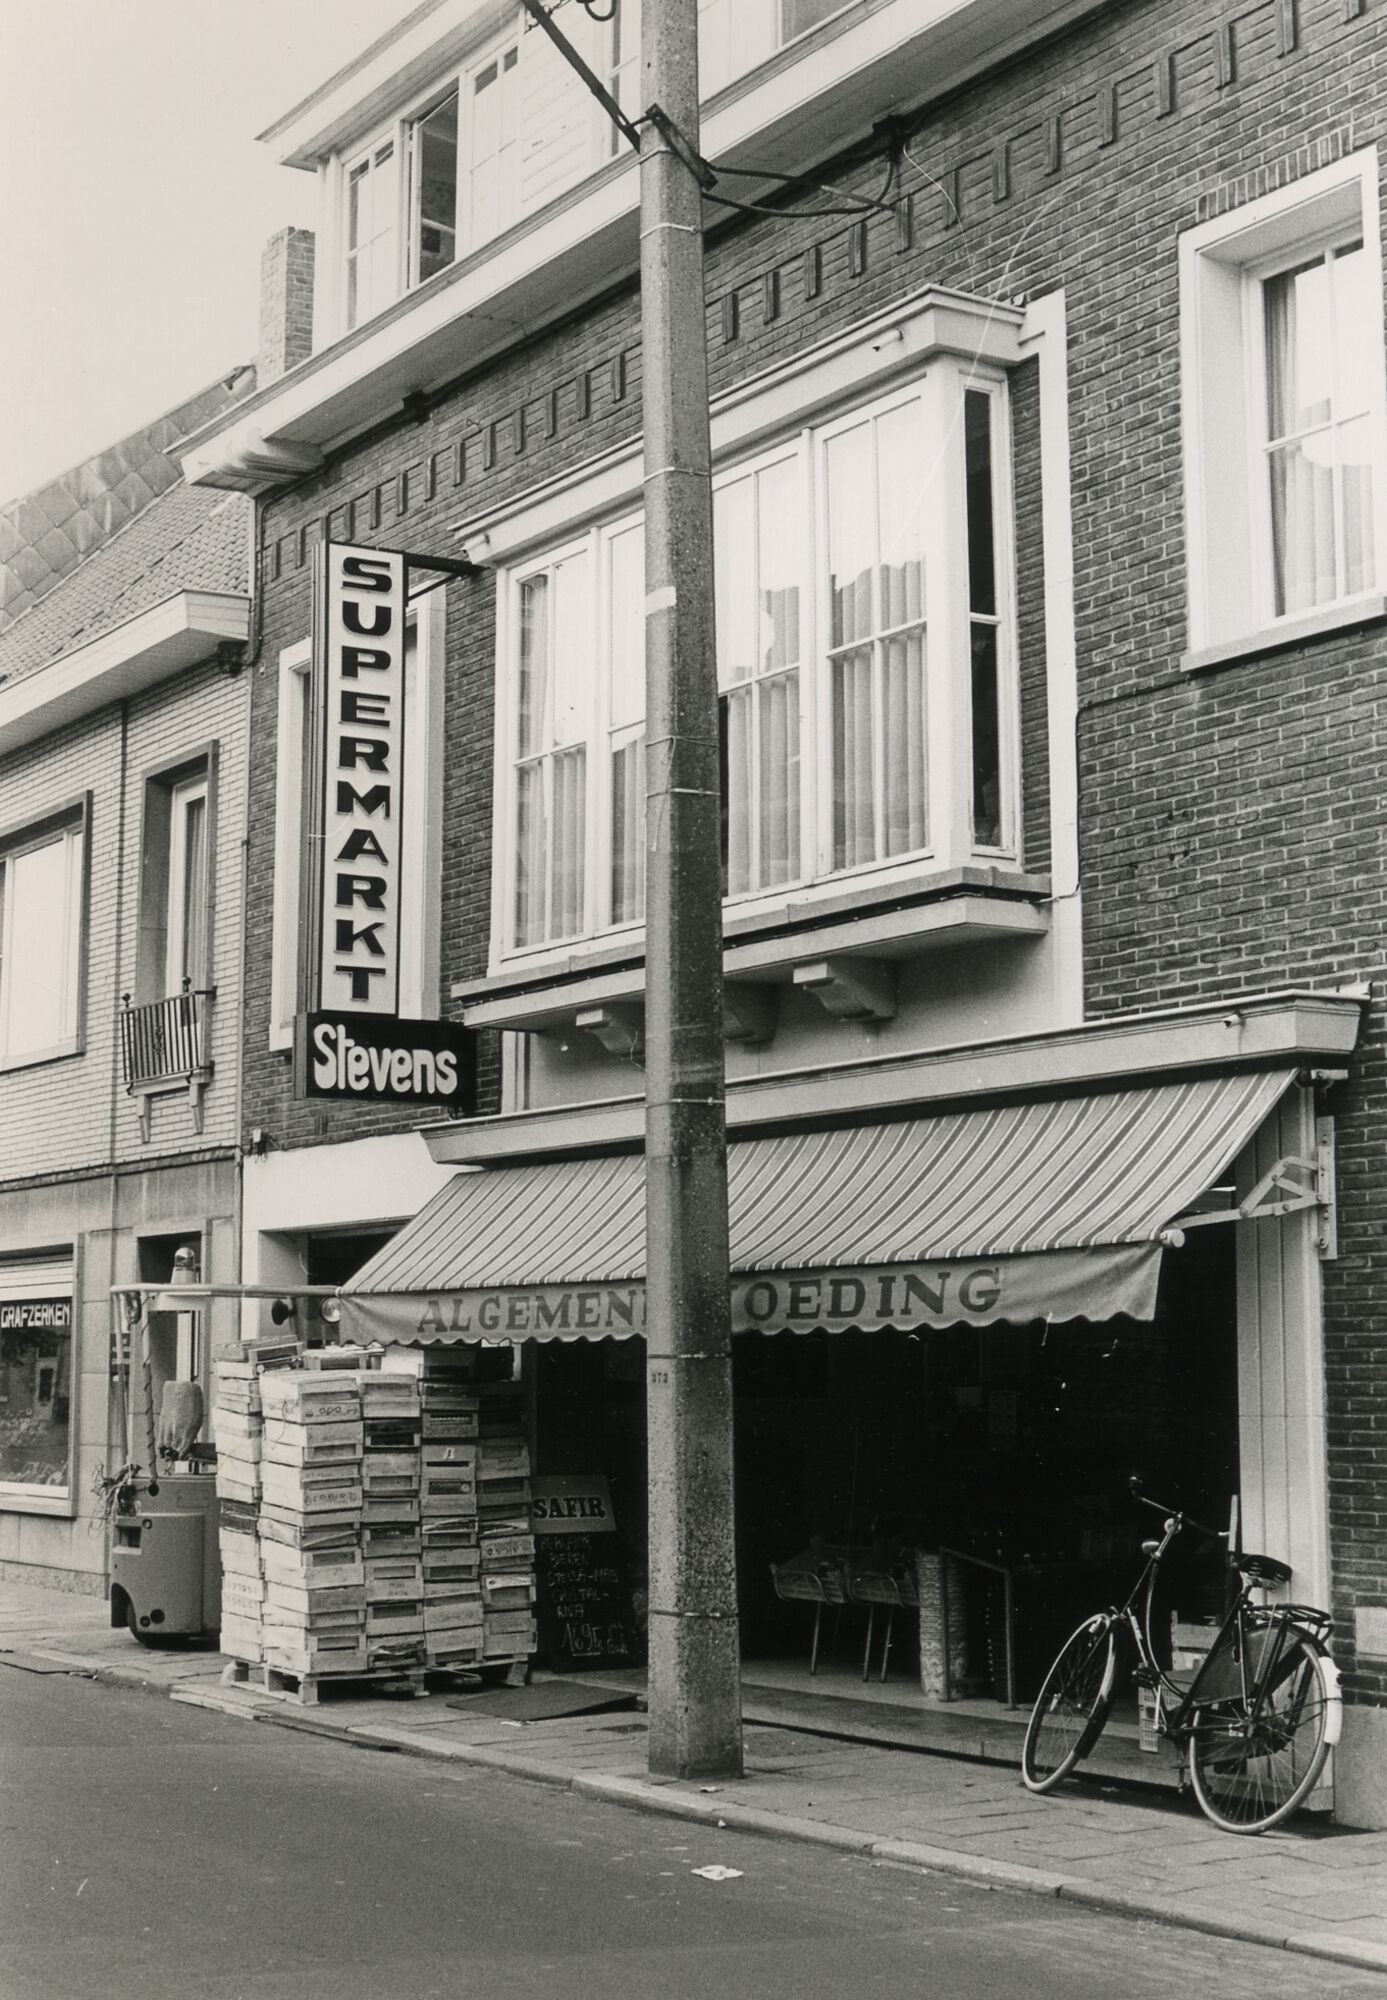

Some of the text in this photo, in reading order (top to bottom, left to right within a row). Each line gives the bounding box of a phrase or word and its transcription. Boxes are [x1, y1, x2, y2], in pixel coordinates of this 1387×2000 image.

[333, 555, 393, 1002] SUPERMARKT
[313, 1022, 459, 1096] Stevens
[1, 1303, 70, 1328] GRAFZERKEN
[416, 1268, 1003, 1334] ALGEMEN OEDING
[533, 1495, 607, 1520] SAFIR
